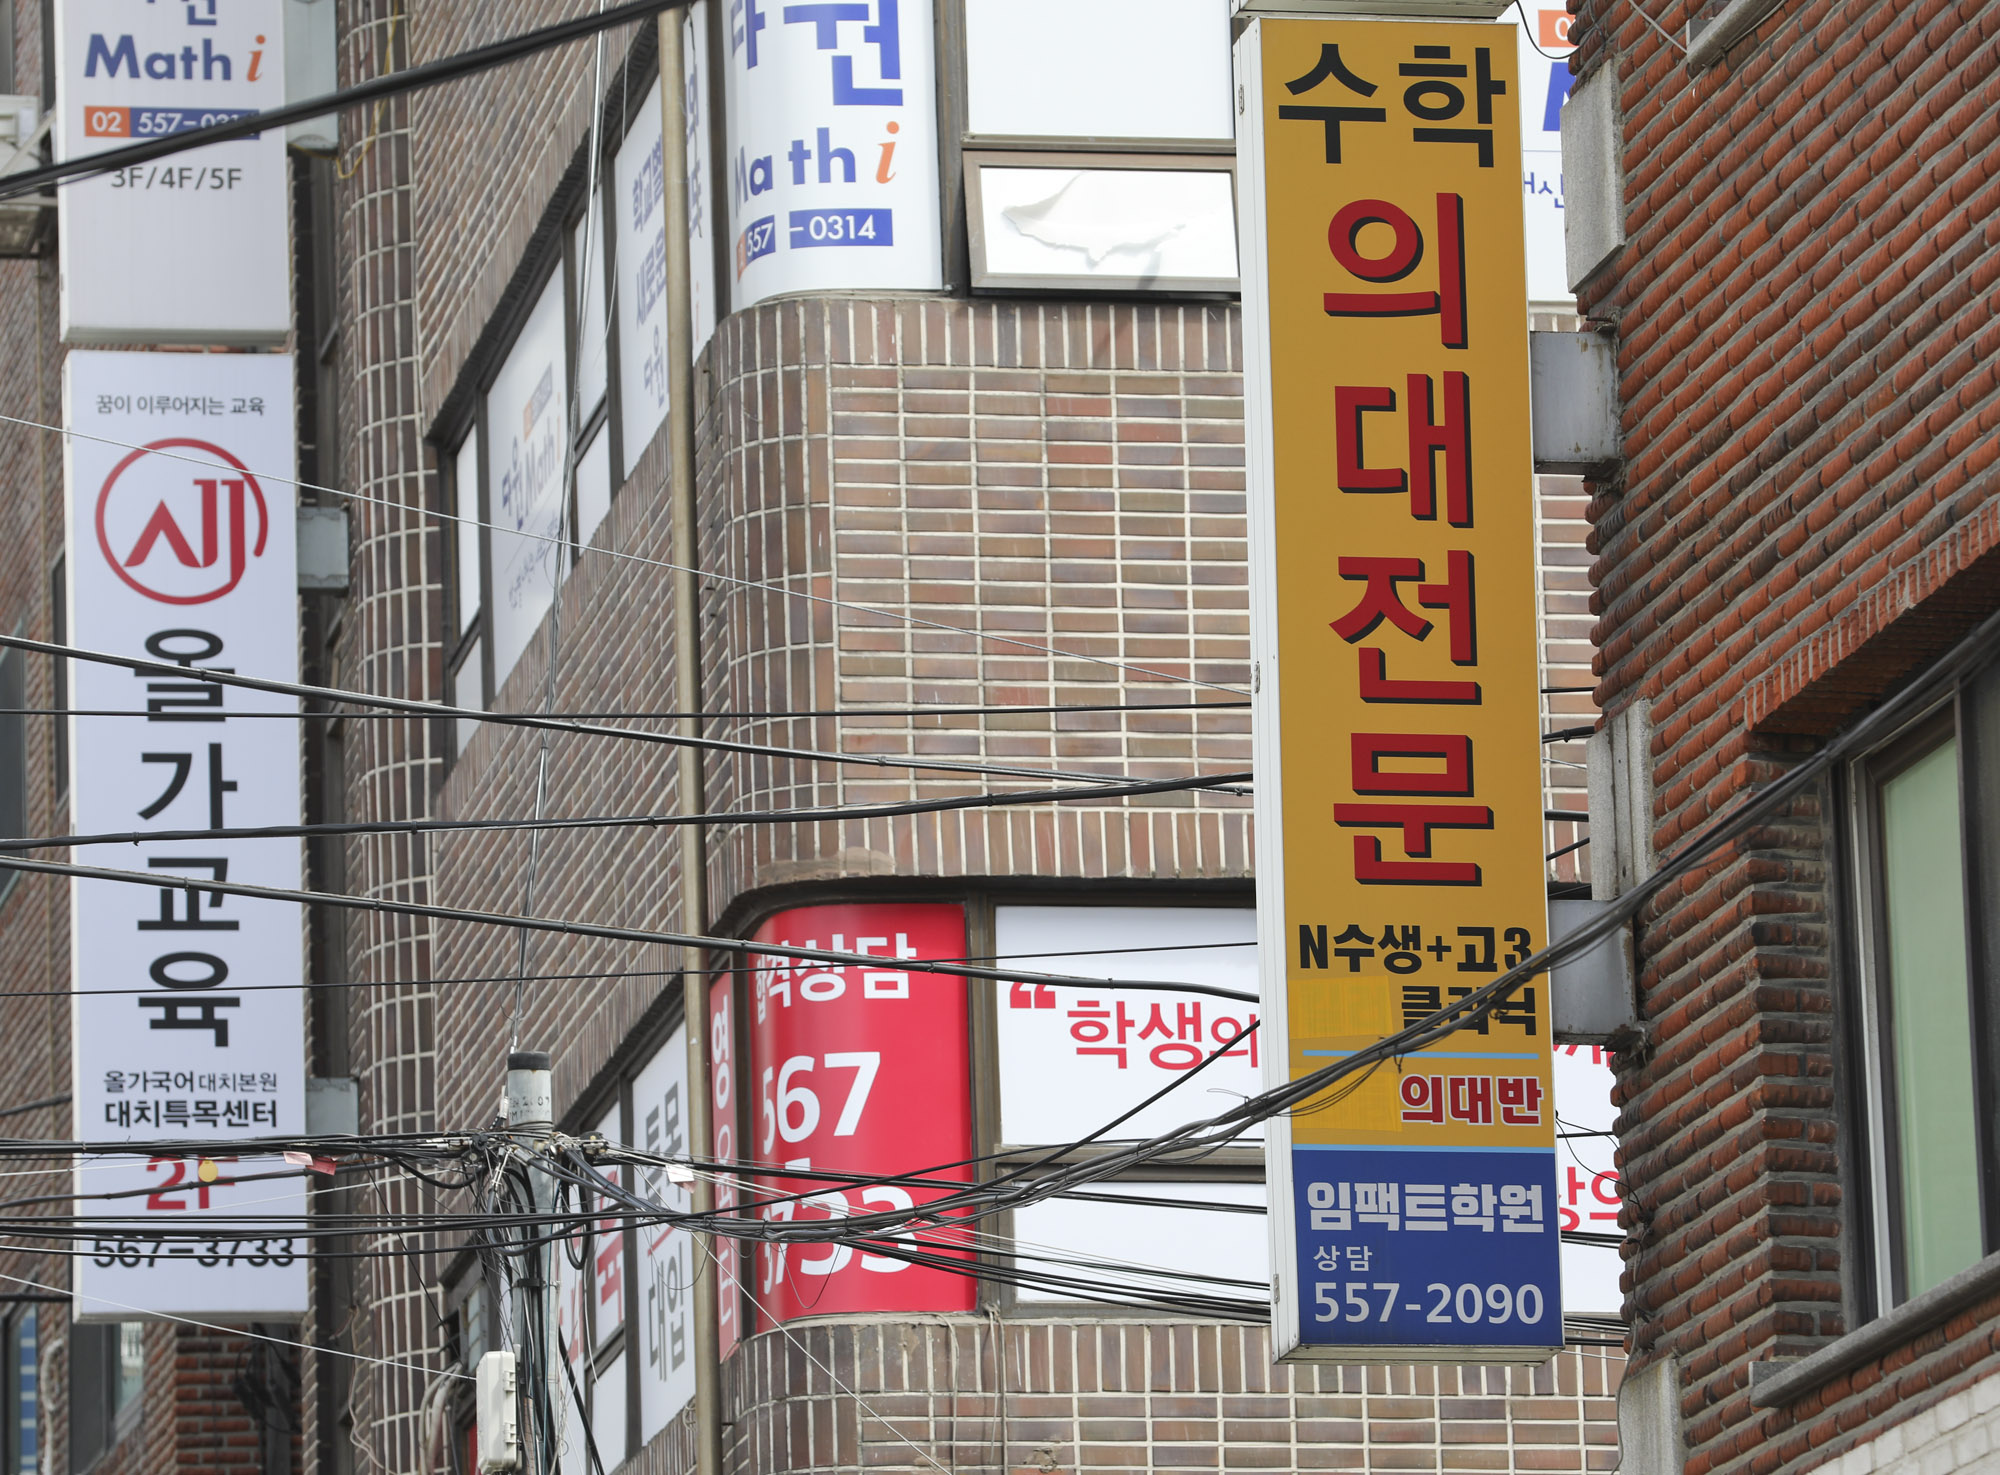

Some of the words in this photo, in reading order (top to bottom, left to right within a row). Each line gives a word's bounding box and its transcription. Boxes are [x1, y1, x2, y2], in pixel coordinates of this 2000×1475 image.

[84, 34, 232, 81] Math
[92, 111, 122, 133] 02
[1279, 43, 1507, 168] 수학
[111, 166, 242, 190] 3F/4F/5F
[97, 395, 131, 414] 꿈이
[136, 396, 225, 416] 이루어지는
[230, 397, 265, 416] 교육
[1299, 924, 1533, 975] N수생+고3
[104, 1071, 194, 1093] 올가국어
[199, 1072, 278, 1093] 대치본원
[763, 1051, 881, 1156] 567
[1400, 1073, 1544, 1126] 의대반
[105, 1100, 278, 1128] 대치특목센터
[146, 1154, 239, 1211] 2F
[1307, 1182, 1545, 1234] 임팩트학원
[1314, 1281, 1544, 1325] 557-2090
